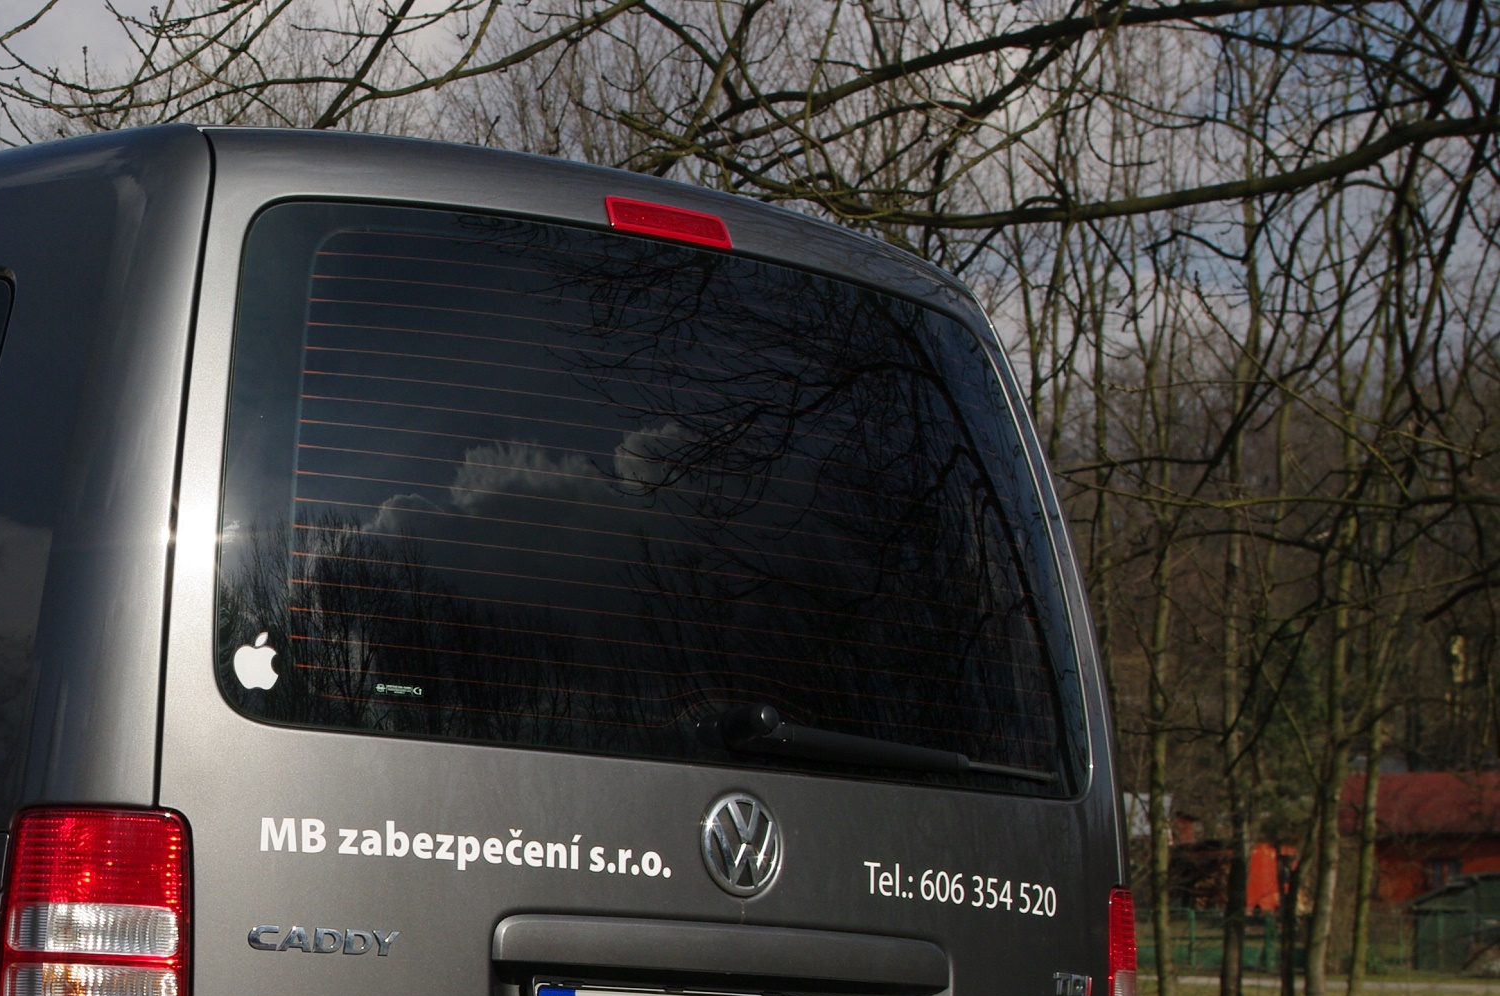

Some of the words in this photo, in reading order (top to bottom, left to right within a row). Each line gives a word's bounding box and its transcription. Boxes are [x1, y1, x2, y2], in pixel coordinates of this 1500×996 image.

[259, 817, 327, 854] MB
[338, 820, 583, 871] zabezpečení
[588, 845, 673, 879] s.r.o.
[863, 861, 914, 899] Tel.:
[920, 869, 965, 905] 606
[971, 875, 1013, 911] 354
[1018, 882, 1058, 918] 520
[247, 924, 401, 957] CADDY
